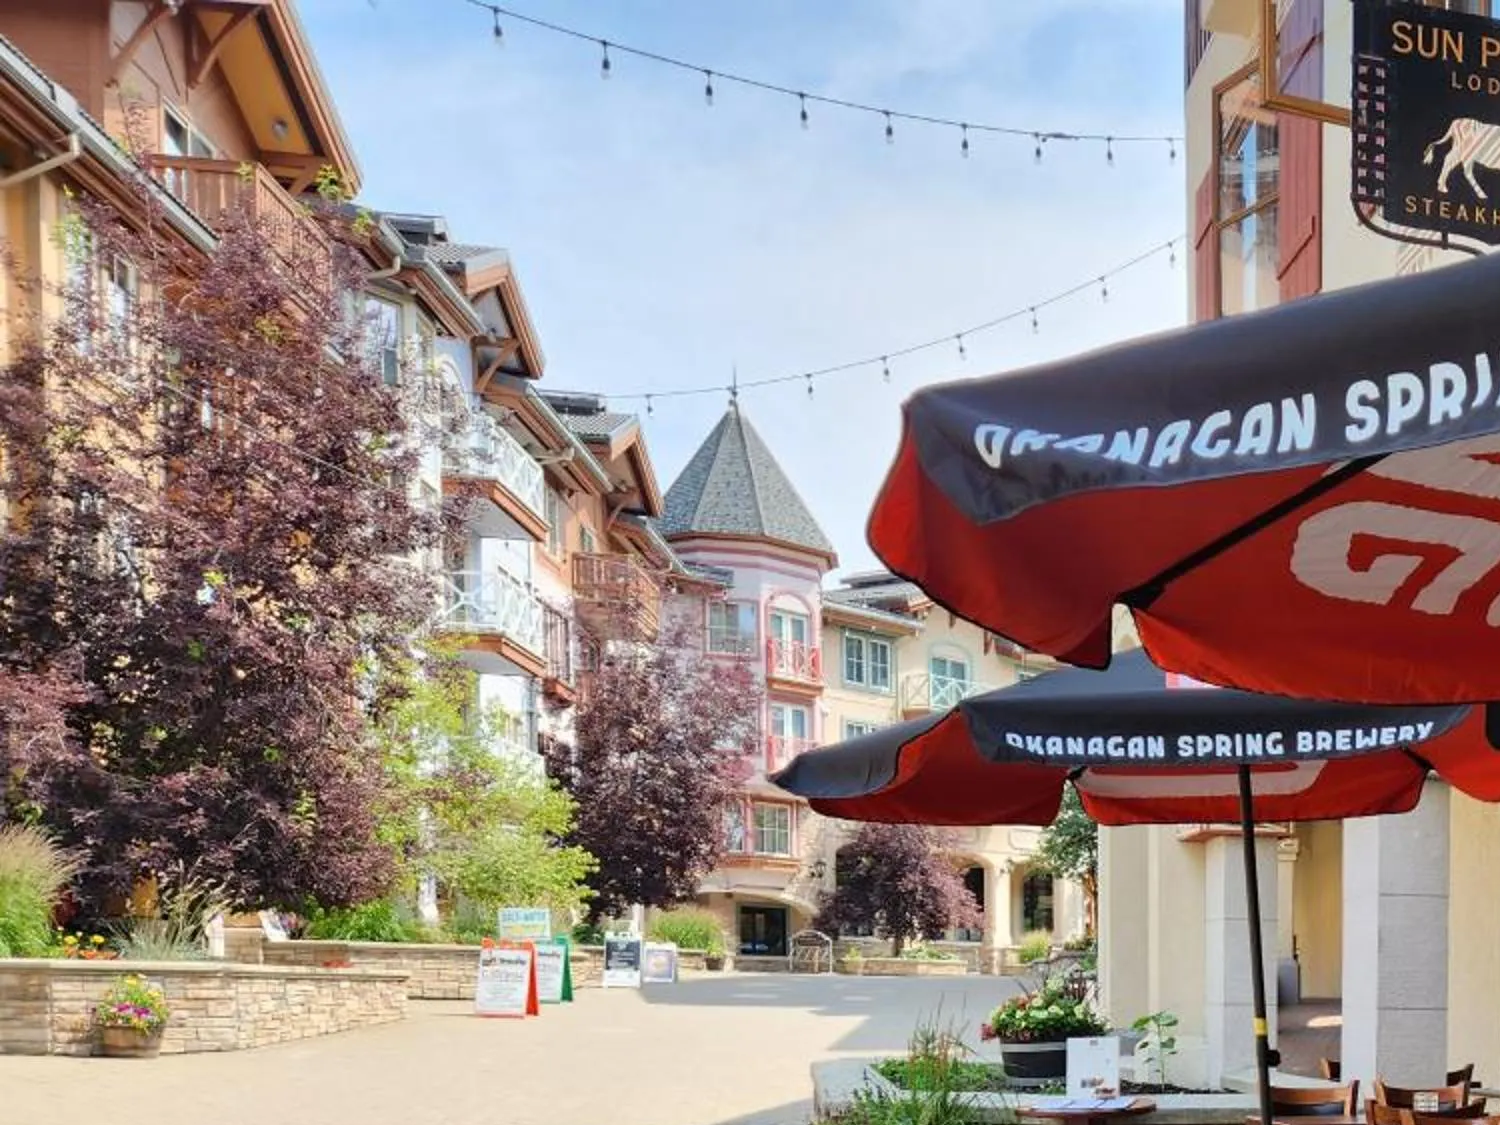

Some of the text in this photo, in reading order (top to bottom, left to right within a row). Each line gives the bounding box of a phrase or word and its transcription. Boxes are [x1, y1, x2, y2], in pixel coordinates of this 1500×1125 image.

[1392, 21, 1464, 63] SUN
[1177, 732, 1285, 757] SPRING
[1296, 721, 1434, 752] BREWERY
